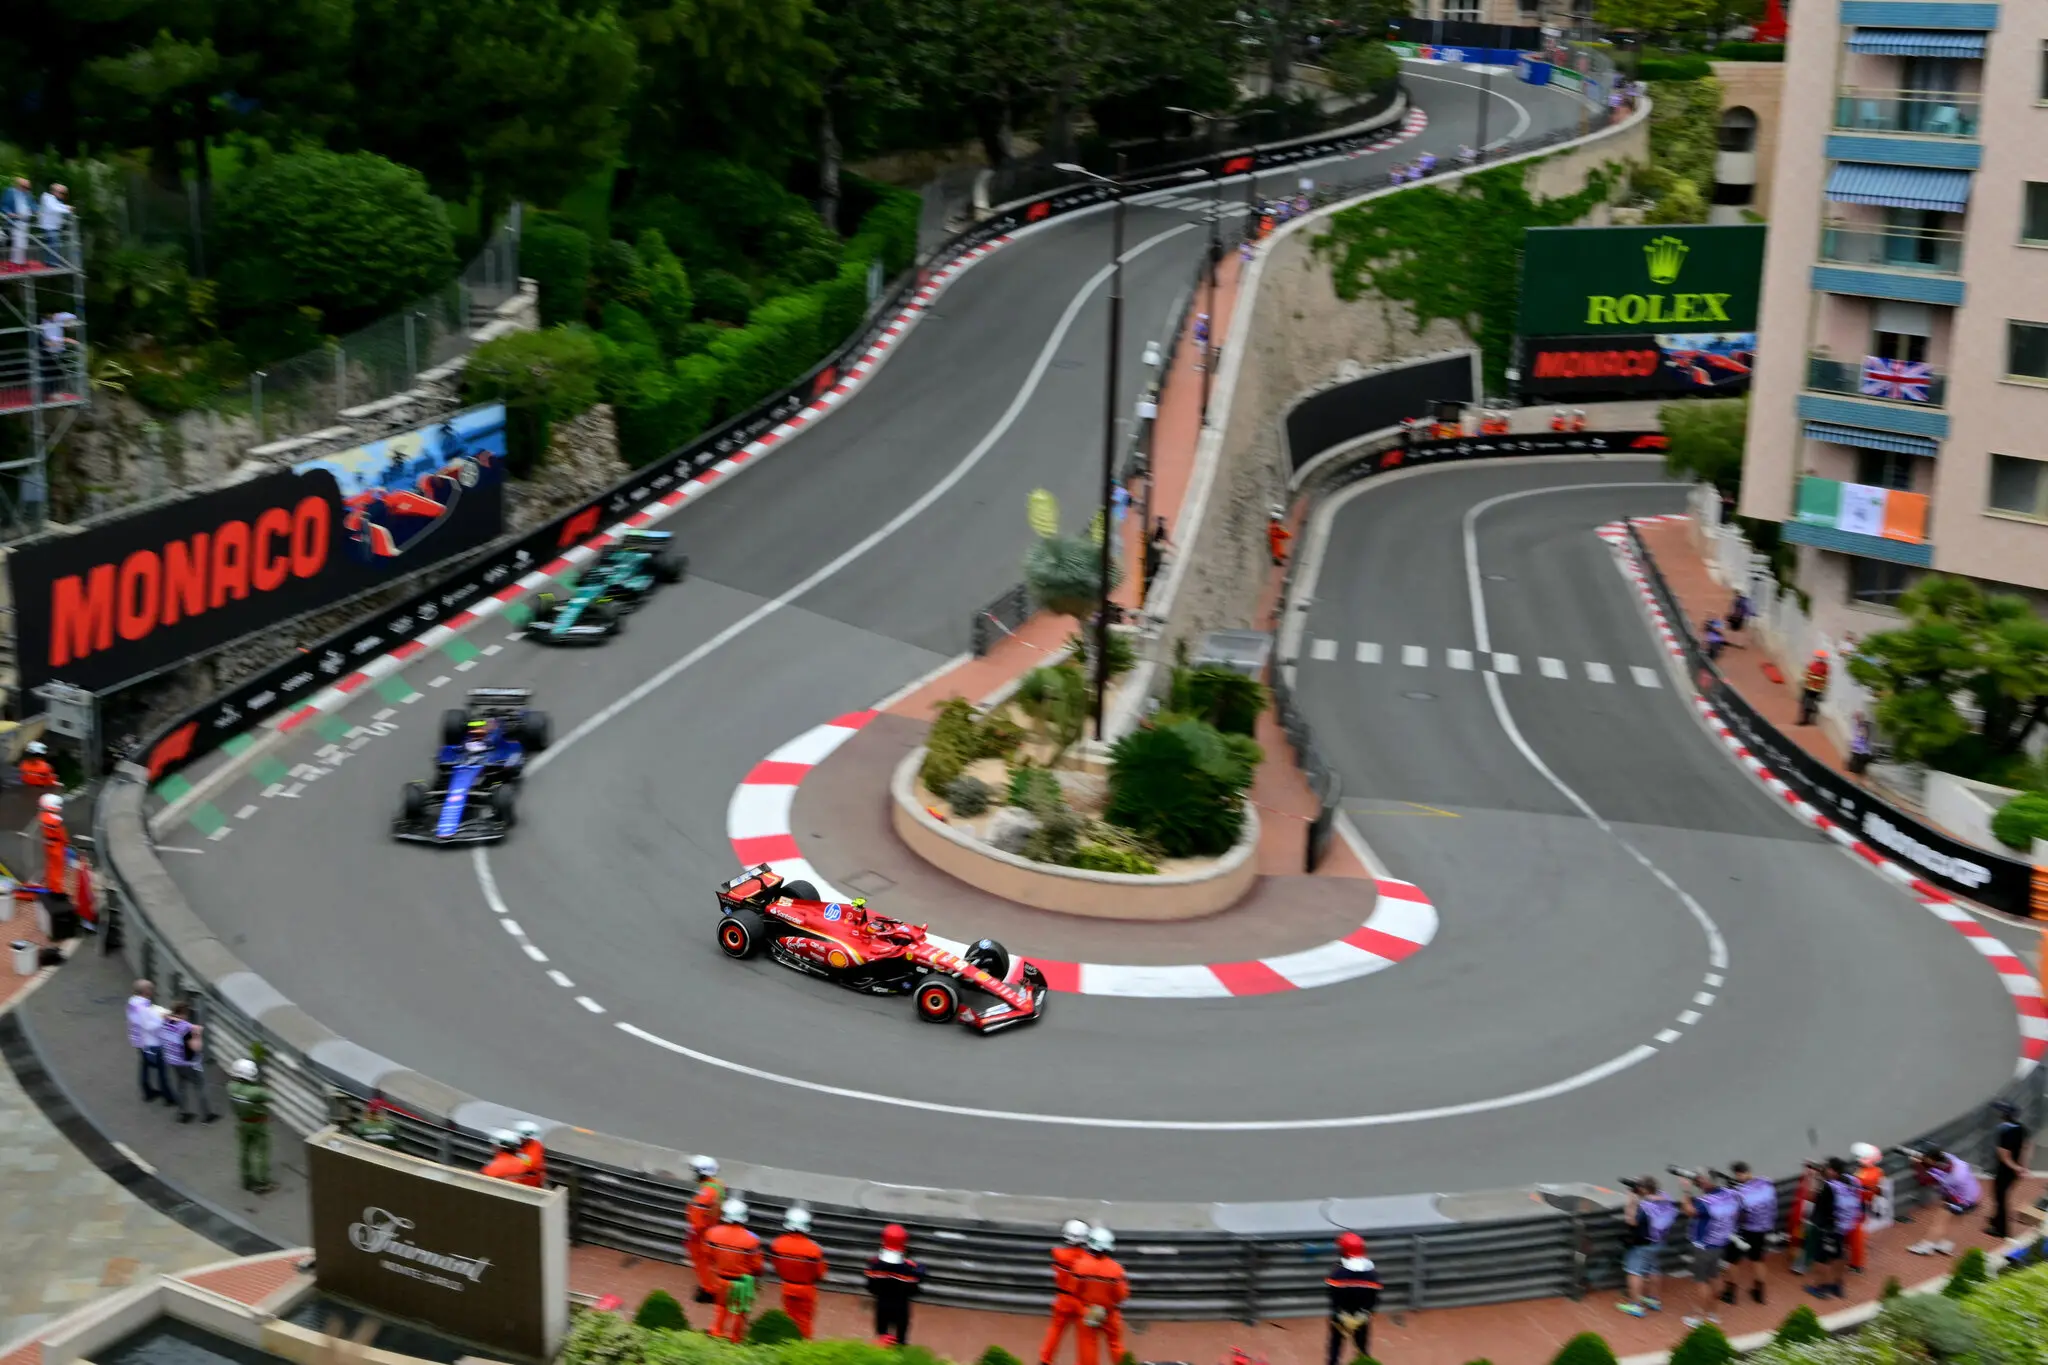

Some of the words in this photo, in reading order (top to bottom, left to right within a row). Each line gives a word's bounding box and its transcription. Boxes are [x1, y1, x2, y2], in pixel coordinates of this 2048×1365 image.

[1584, 293, 1732, 324] ROLEX
[1534, 350, 1659, 378] MONACO
[48, 496, 331, 667] MONACO
[776, 909, 804, 925] Santander
[825, 903, 841, 920] hp
